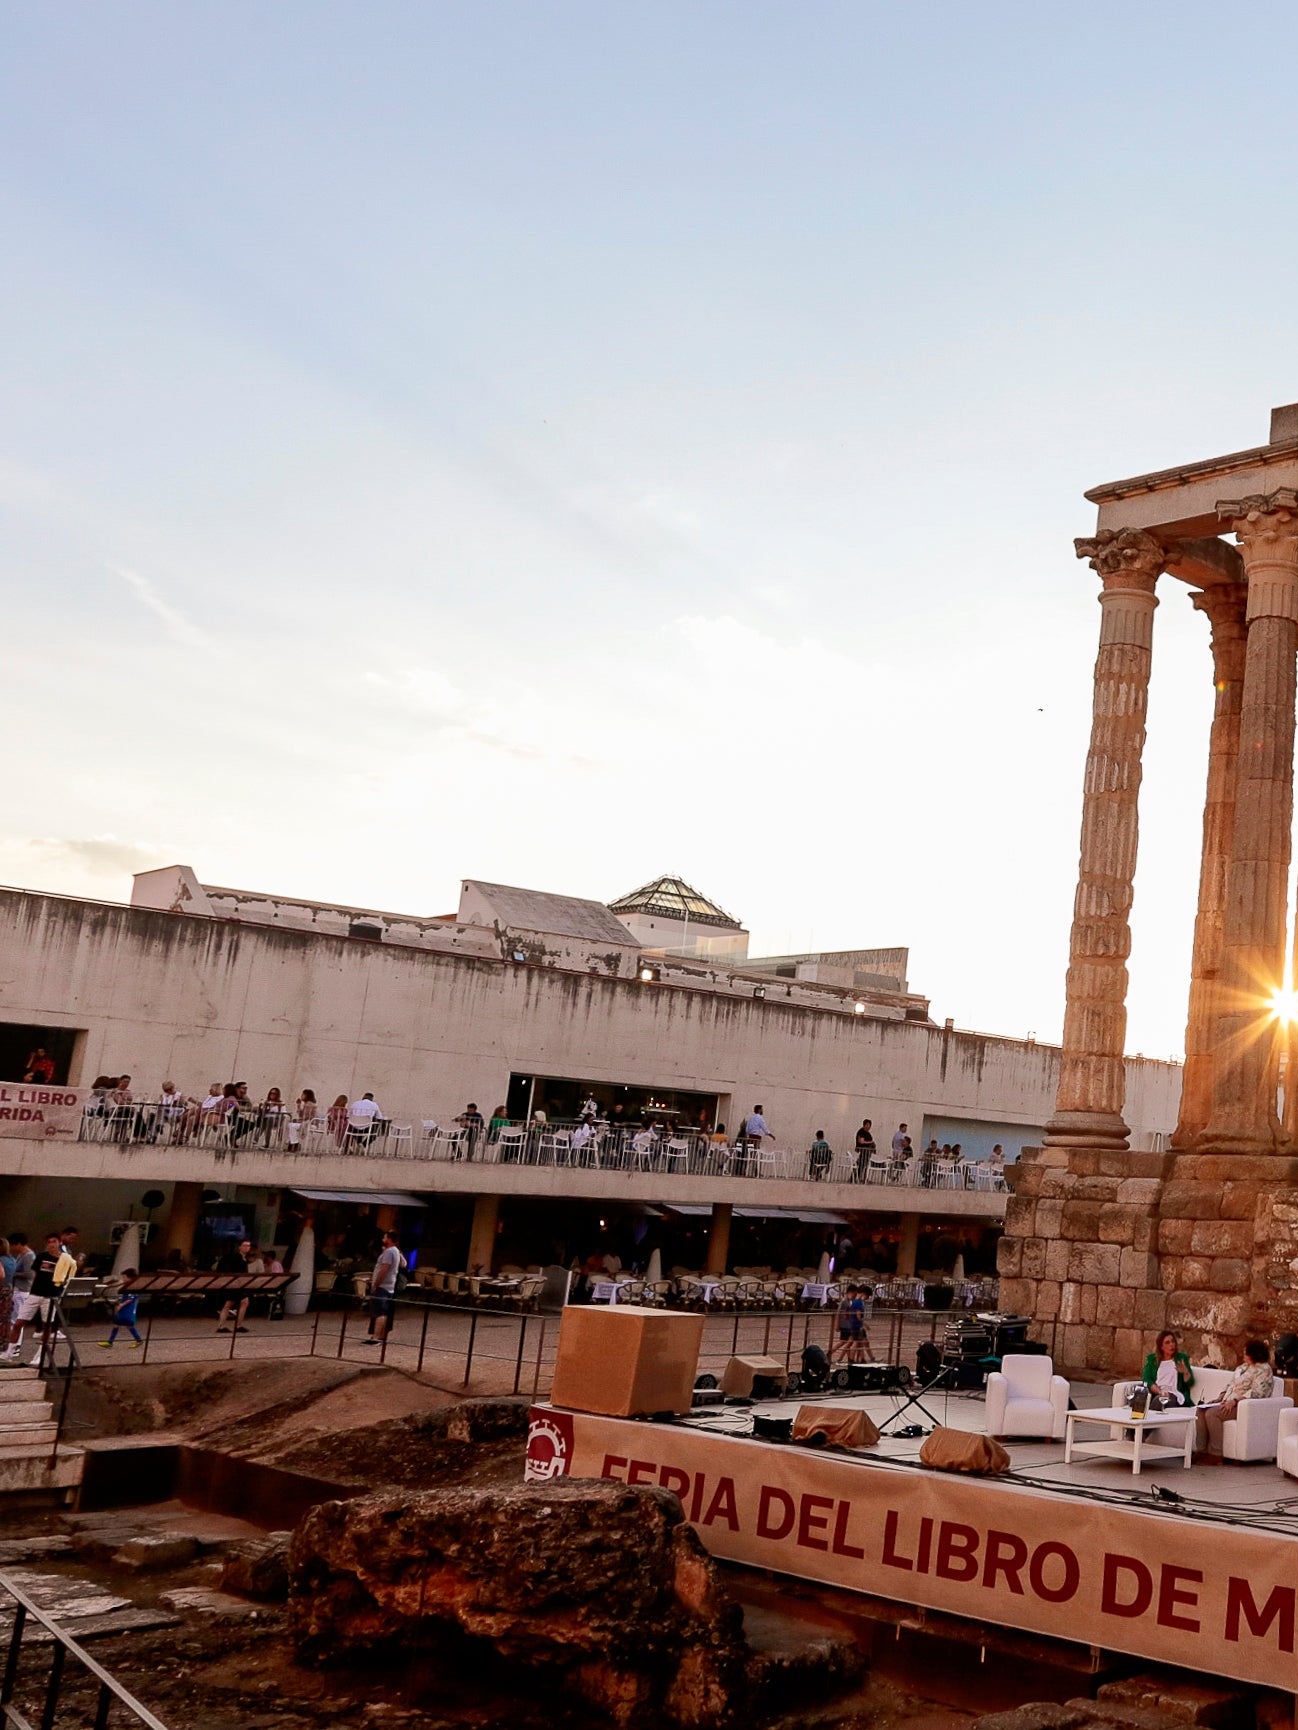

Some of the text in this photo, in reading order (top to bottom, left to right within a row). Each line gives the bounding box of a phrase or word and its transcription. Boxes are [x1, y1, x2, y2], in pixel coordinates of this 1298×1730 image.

[19, 1090, 77, 1107] LIBRO
[757, 1485, 865, 1559] DEL
[881, 1510, 1080, 1602] LIBRO
[1101, 1553, 1203, 1633] DE
